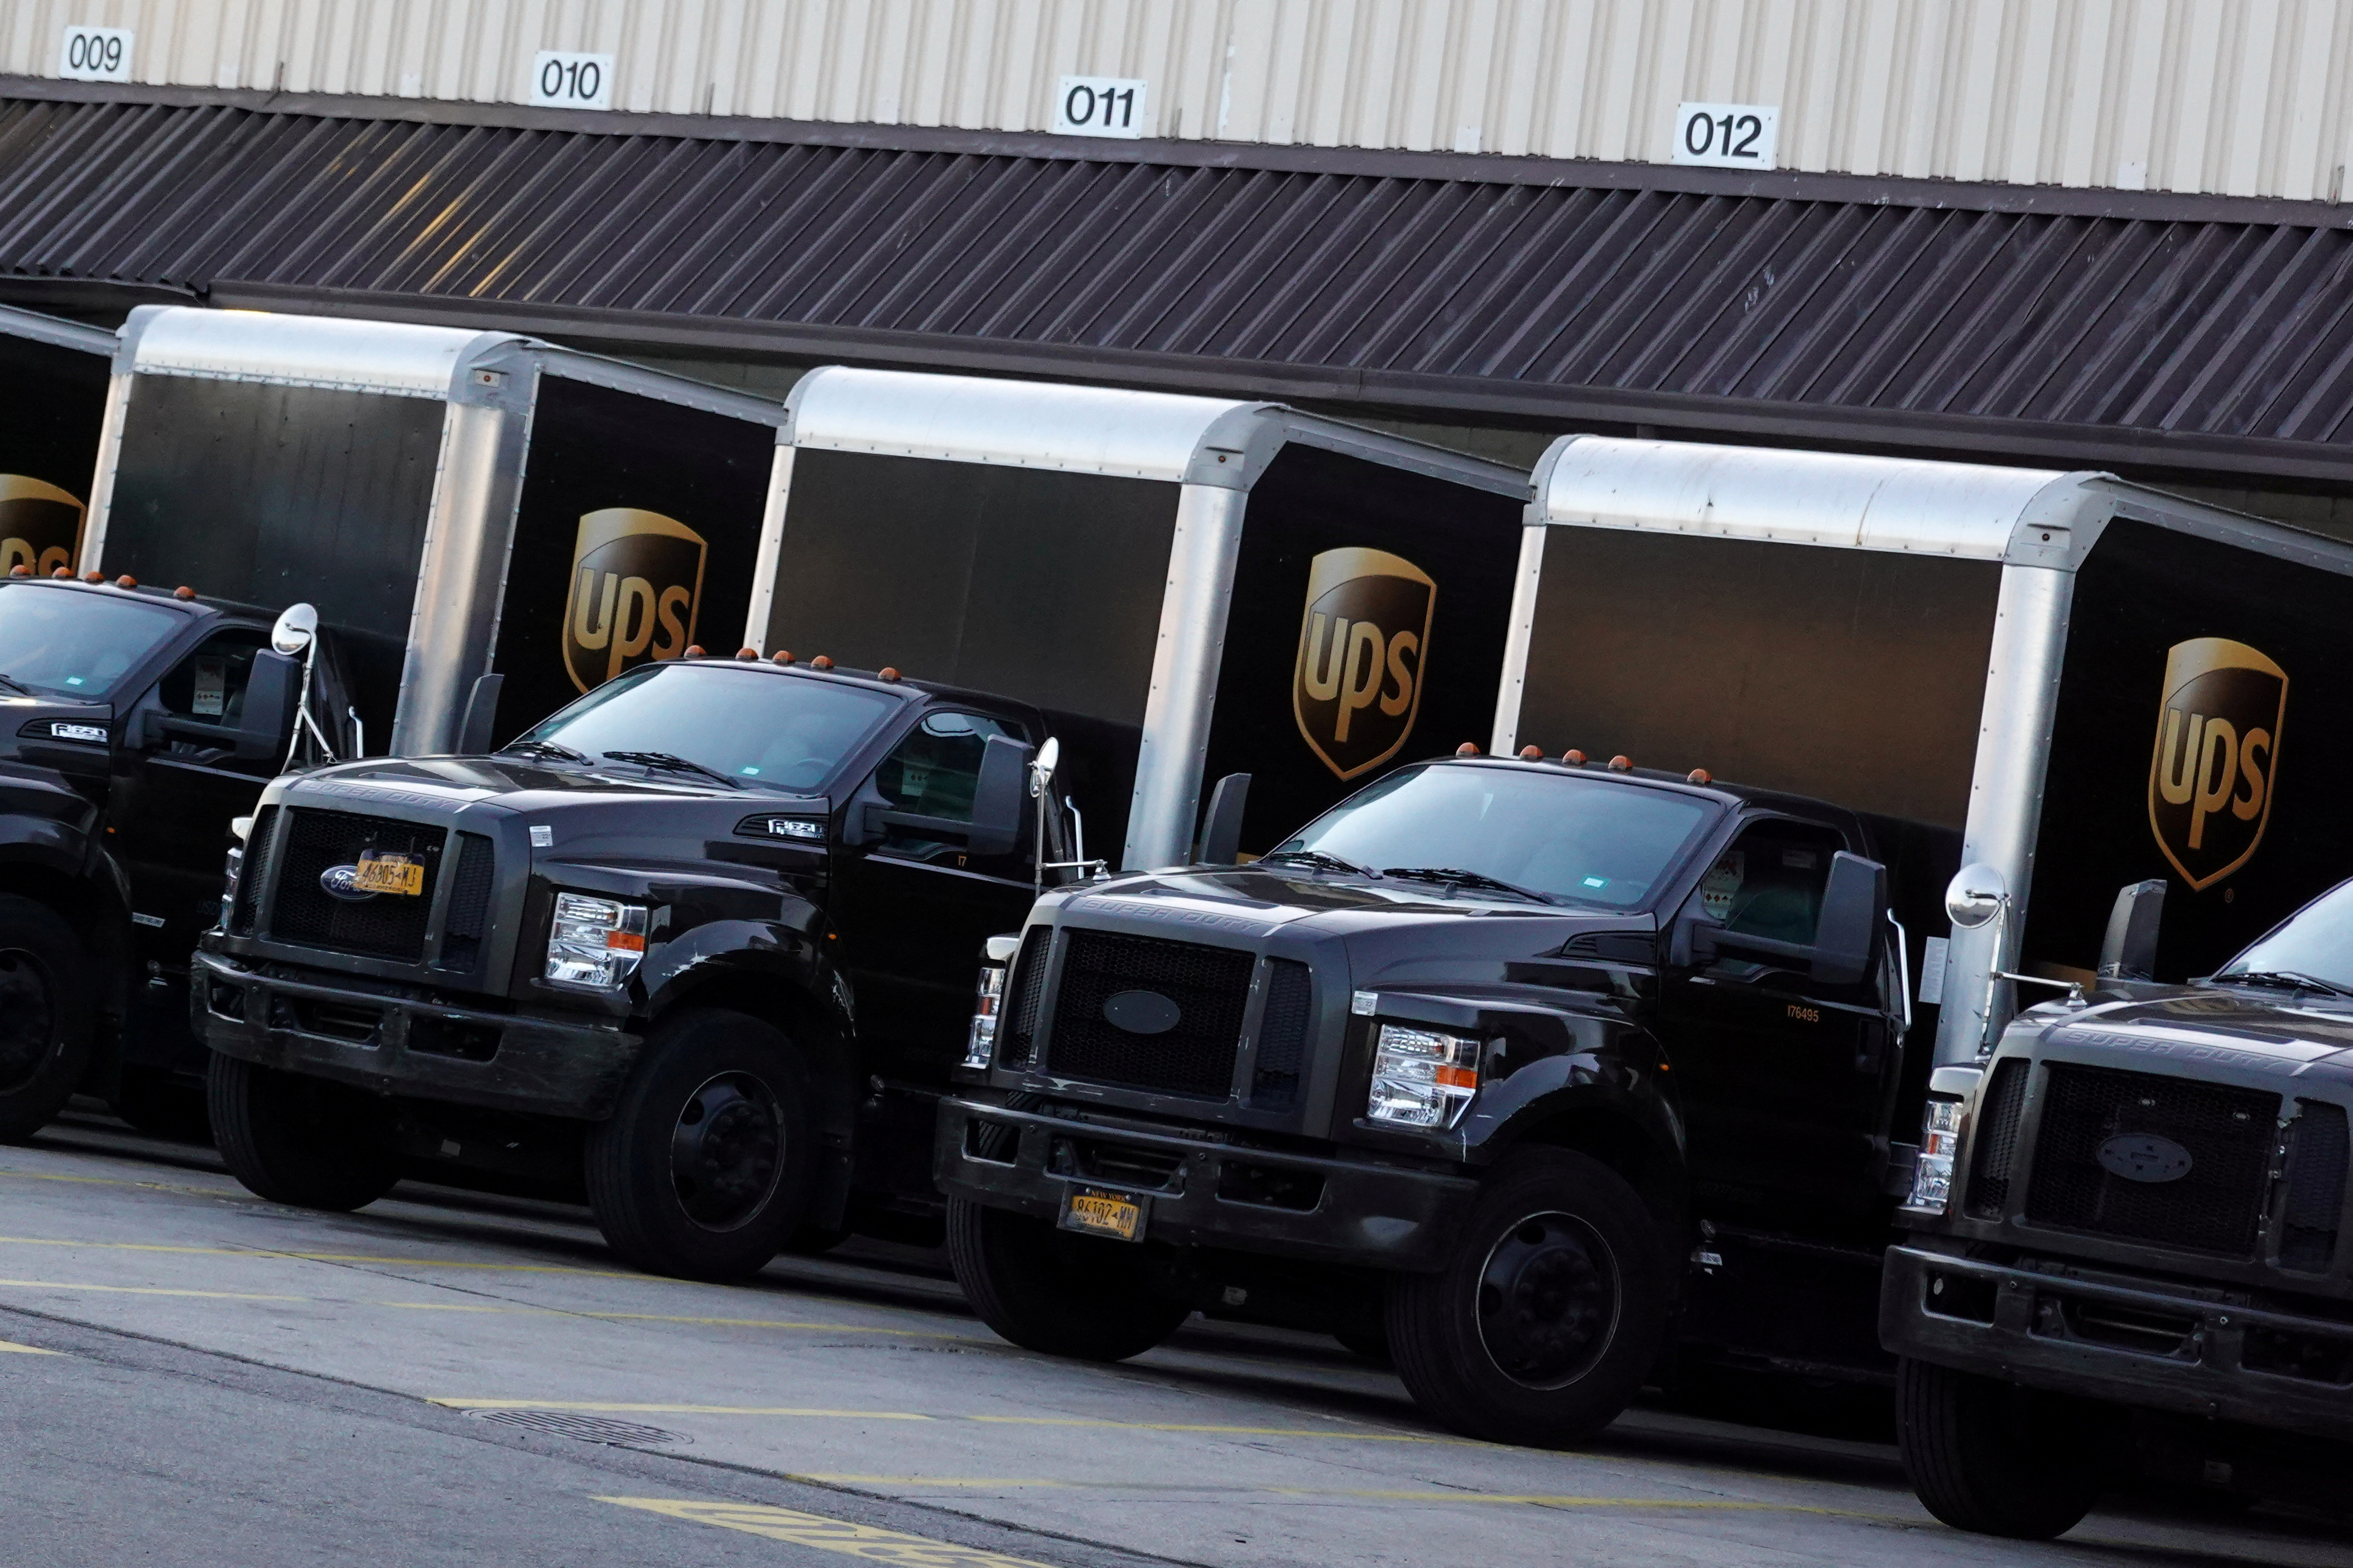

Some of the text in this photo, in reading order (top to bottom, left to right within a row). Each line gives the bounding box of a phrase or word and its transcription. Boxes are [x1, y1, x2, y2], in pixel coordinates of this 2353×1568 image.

[70, 34, 121, 72] 009
[541, 60, 599, 99] 010
[1066, 85, 1134, 128] 011
[1685, 113, 1762, 158] 012
[306, 782, 458, 809] SUPER DUTY
[331, 870, 360, 892] For
[1082, 900, 1260, 932] SUPER DUTY
[1787, 1005, 1819, 1022] 176495
[2065, 1031, 2283, 1070] SUPER DUTY
[1091, 1190, 1127, 1203] NEW YORK
